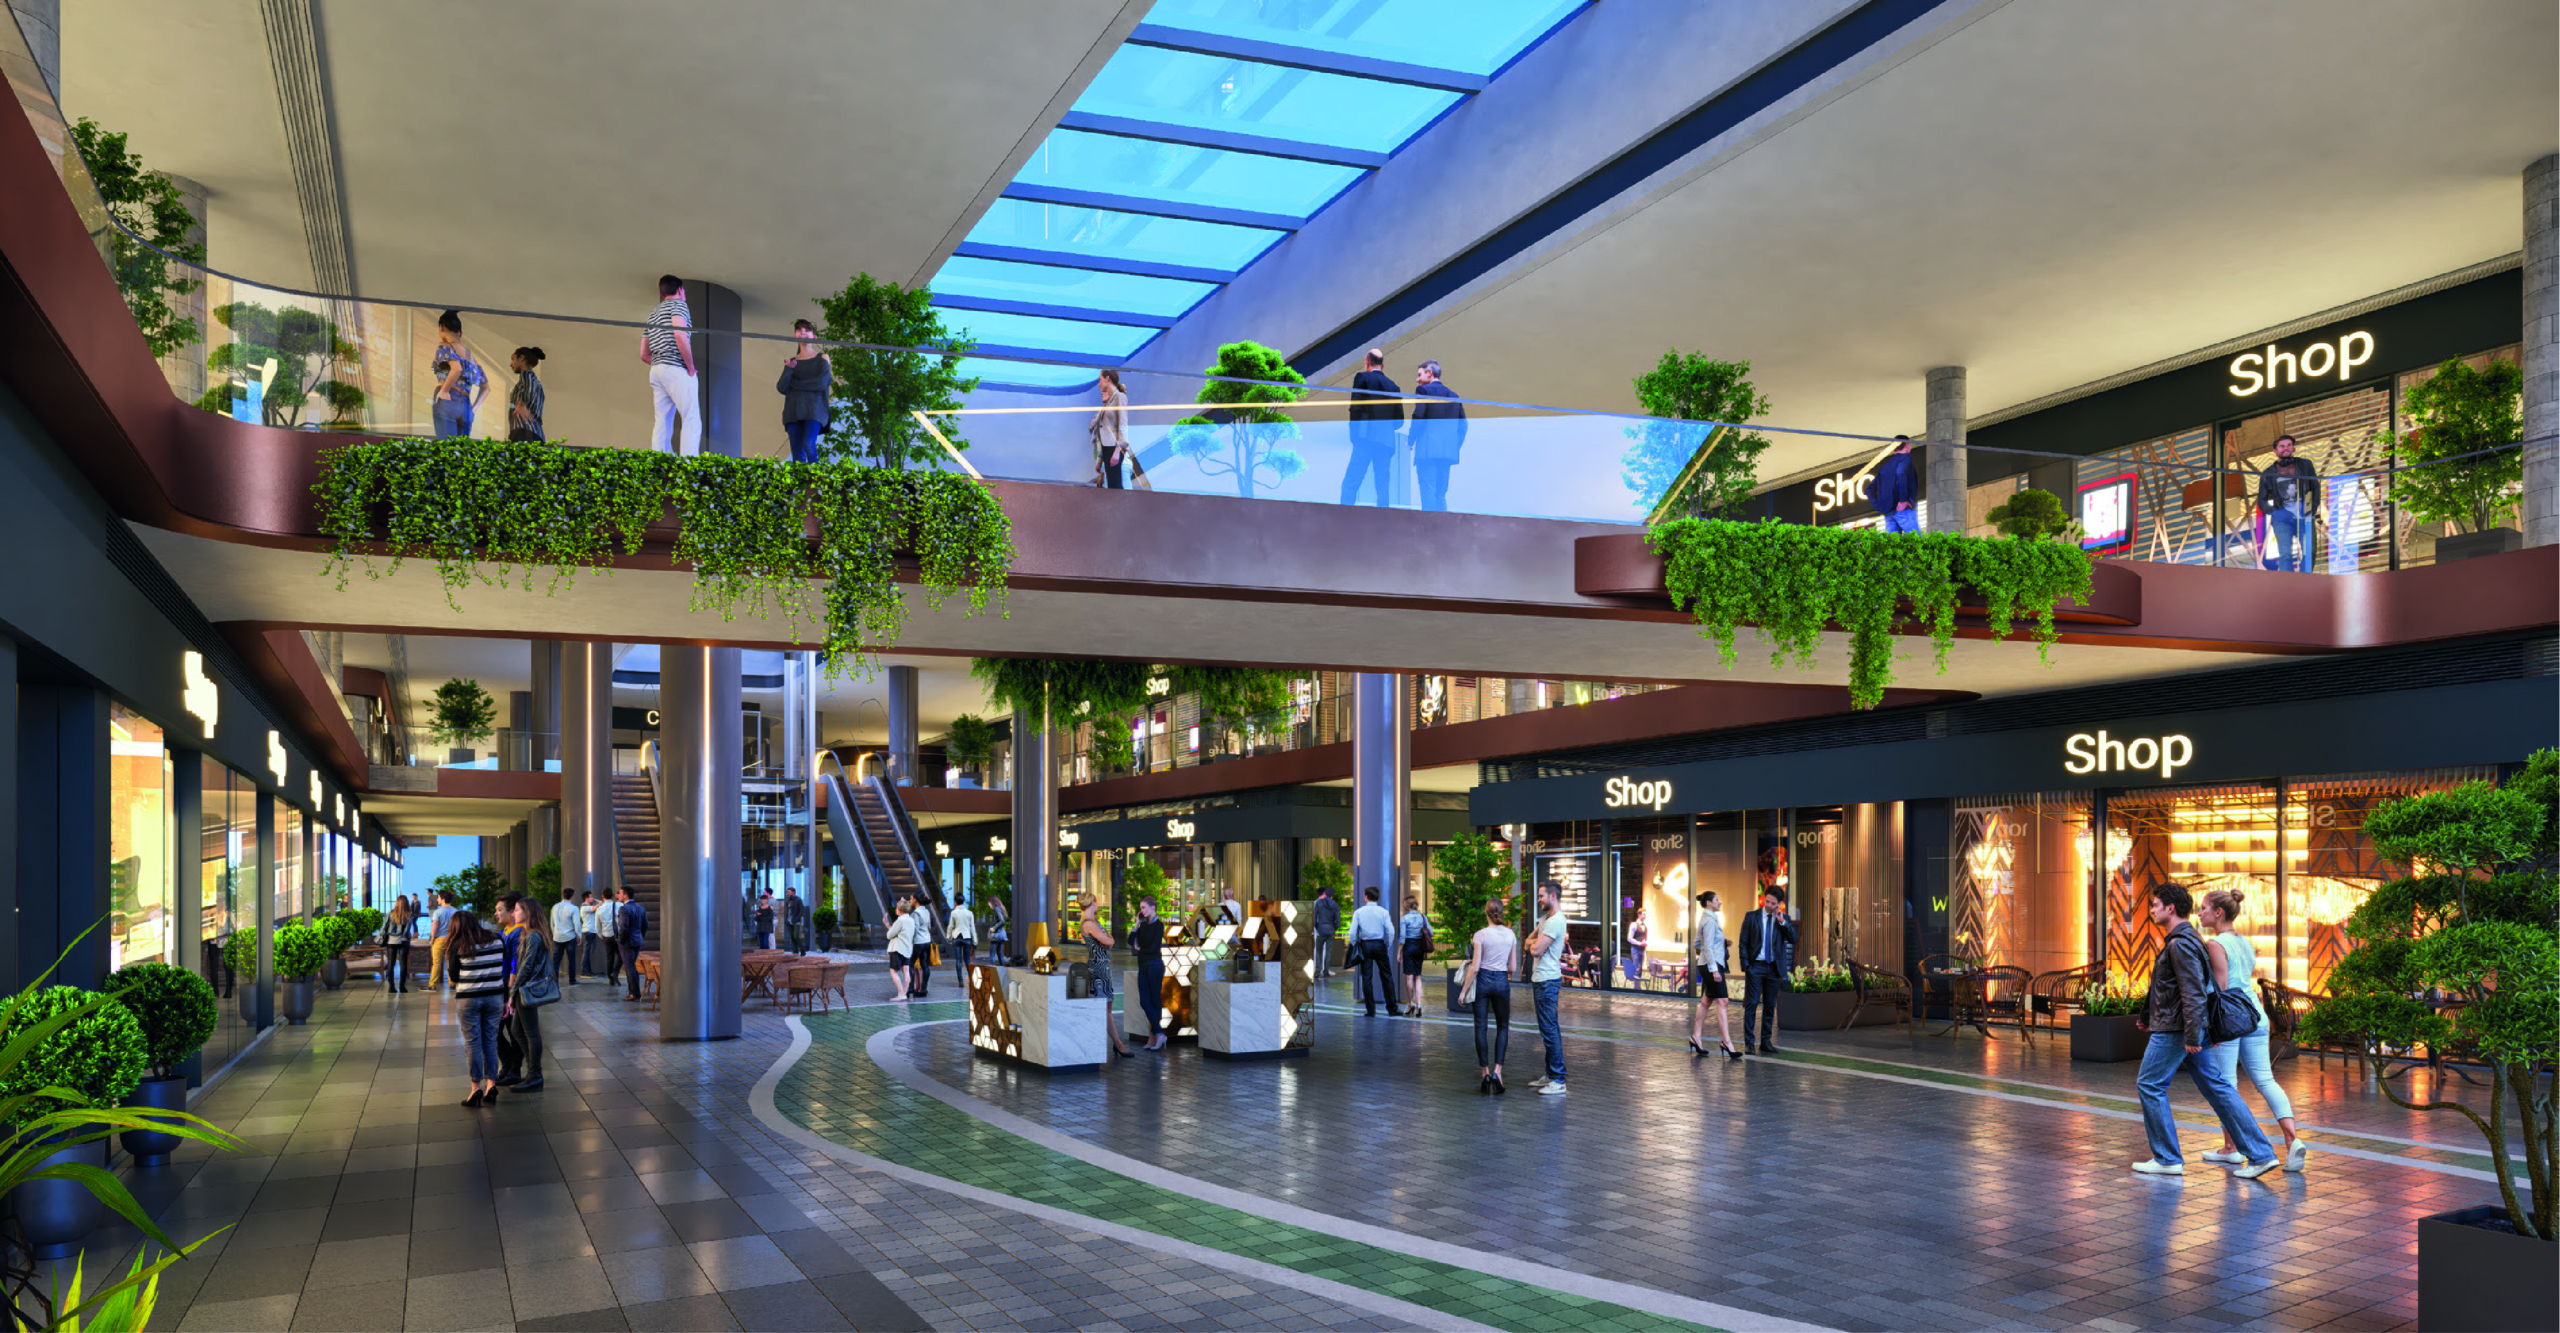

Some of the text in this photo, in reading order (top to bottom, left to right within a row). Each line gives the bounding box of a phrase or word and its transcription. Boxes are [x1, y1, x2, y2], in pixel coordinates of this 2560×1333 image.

[2229, 330, 2374, 397] Shop
[1814, 472, 1876, 511] Sho
[1146, 677, 1170, 696] Shop
[2064, 729, 2193, 778] Shop
[1605, 775, 1672, 811] Shop
[1059, 829, 1079, 850] Shop
[1167, 818, 1195, 842] Shop
